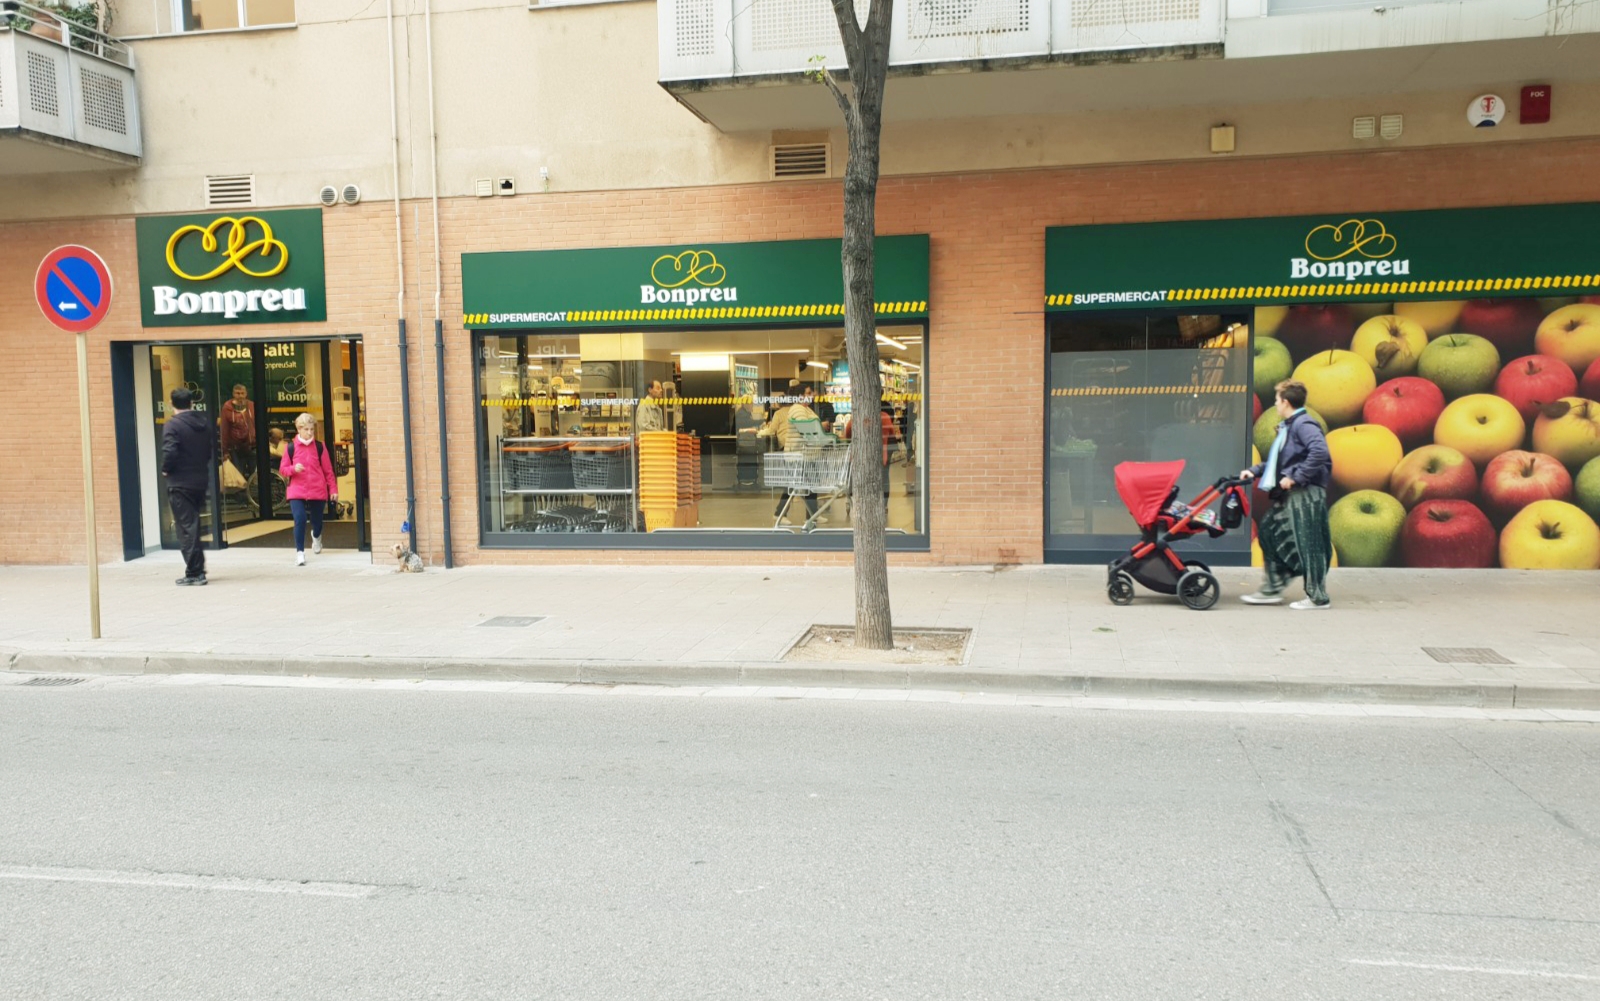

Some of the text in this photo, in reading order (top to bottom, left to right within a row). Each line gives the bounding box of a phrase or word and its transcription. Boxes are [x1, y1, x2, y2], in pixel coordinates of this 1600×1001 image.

[1290, 257, 1410, 280] Bonpreu
[152, 285, 307, 319] Bonpreu
[640, 285, 738, 306] Bonpreu
[1073, 290, 1168, 305] SUPERMERCAT
[489, 312, 567, 324] SUPERMERCAT
[580, 398, 639, 406] SUPERMERCAT
[753, 395, 814, 404] SUPERMERCAT
